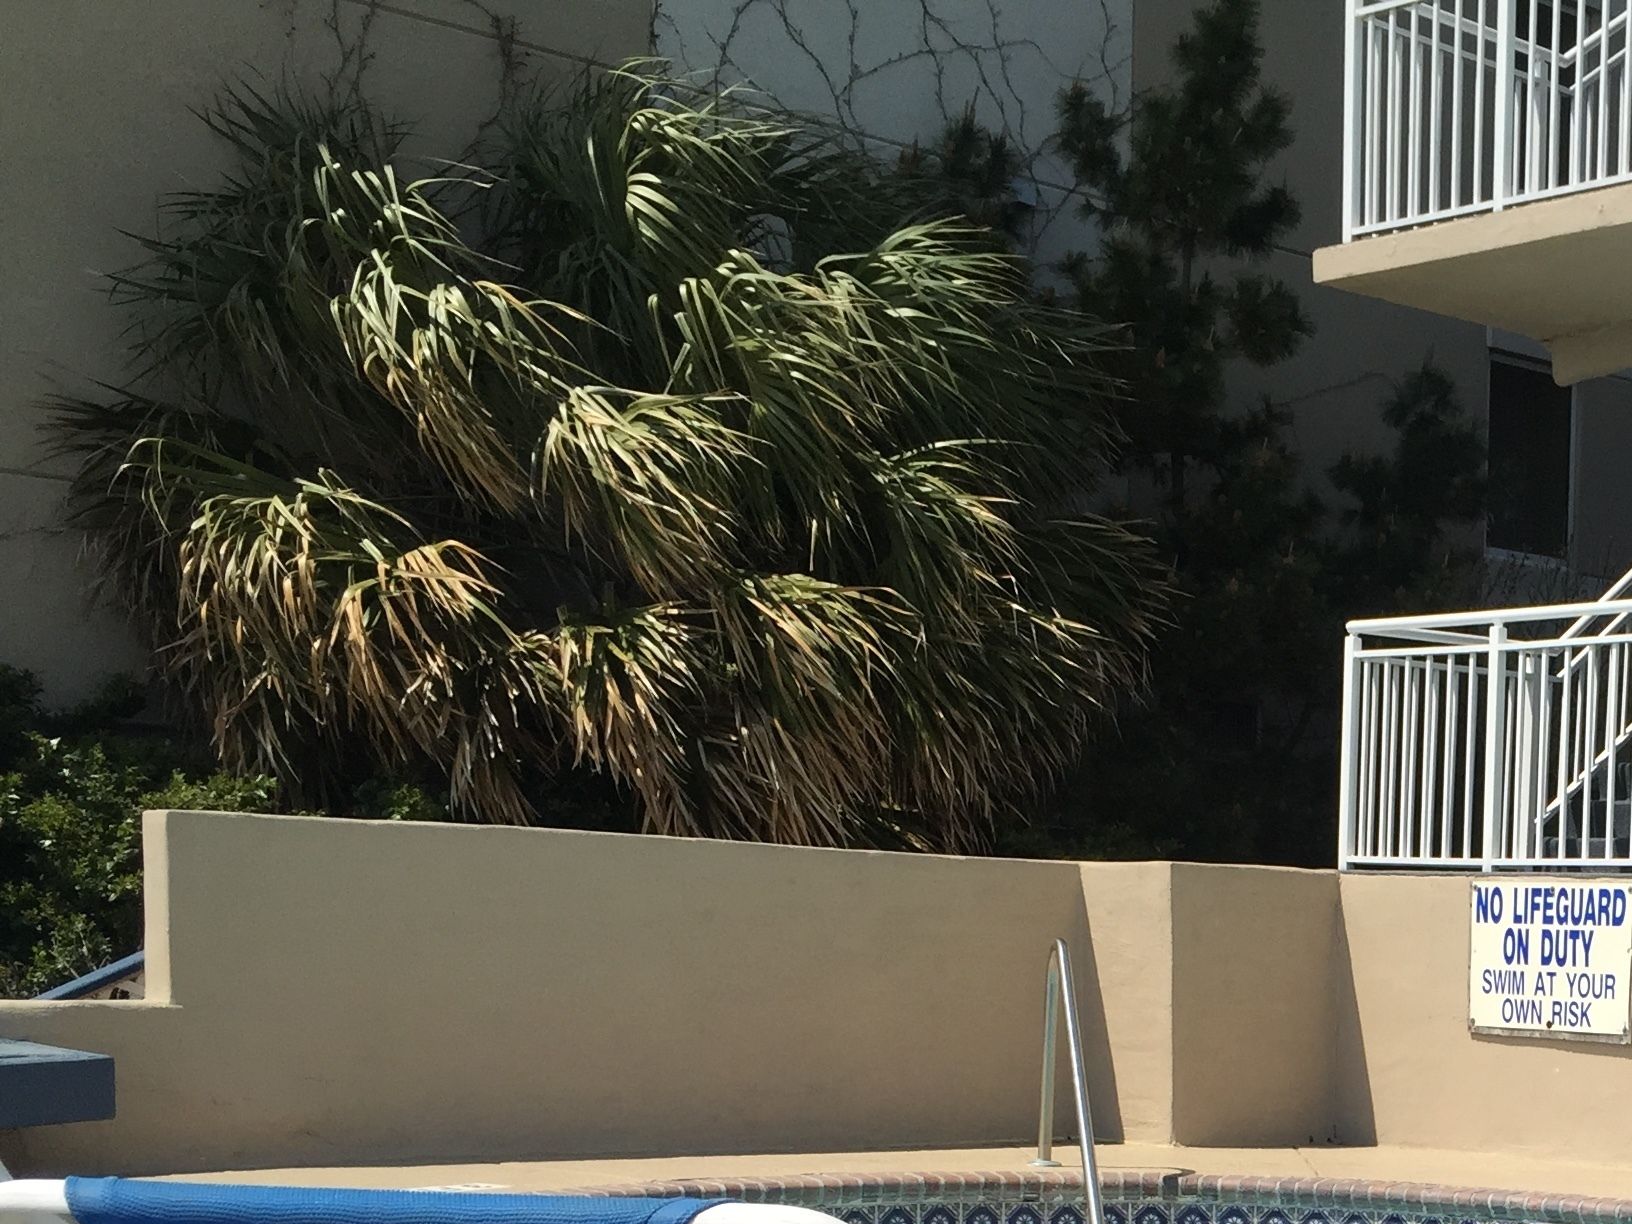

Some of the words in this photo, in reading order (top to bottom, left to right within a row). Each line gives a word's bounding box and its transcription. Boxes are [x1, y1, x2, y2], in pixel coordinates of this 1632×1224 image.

[1475, 886, 1503, 924] NO
[1512, 887, 1627, 926] LIFEGUARD
[1503, 927, 1530, 965] ON
[1540, 928, 1594, 967] DUTY
[1481, 968, 1525, 996] SWIM
[1533, 971, 1557, 997] AT
[1565, 972, 1616, 1000] YOUR
[1501, 997, 1542, 1024] OWN
[1551, 1000, 1592, 1028] RISK
